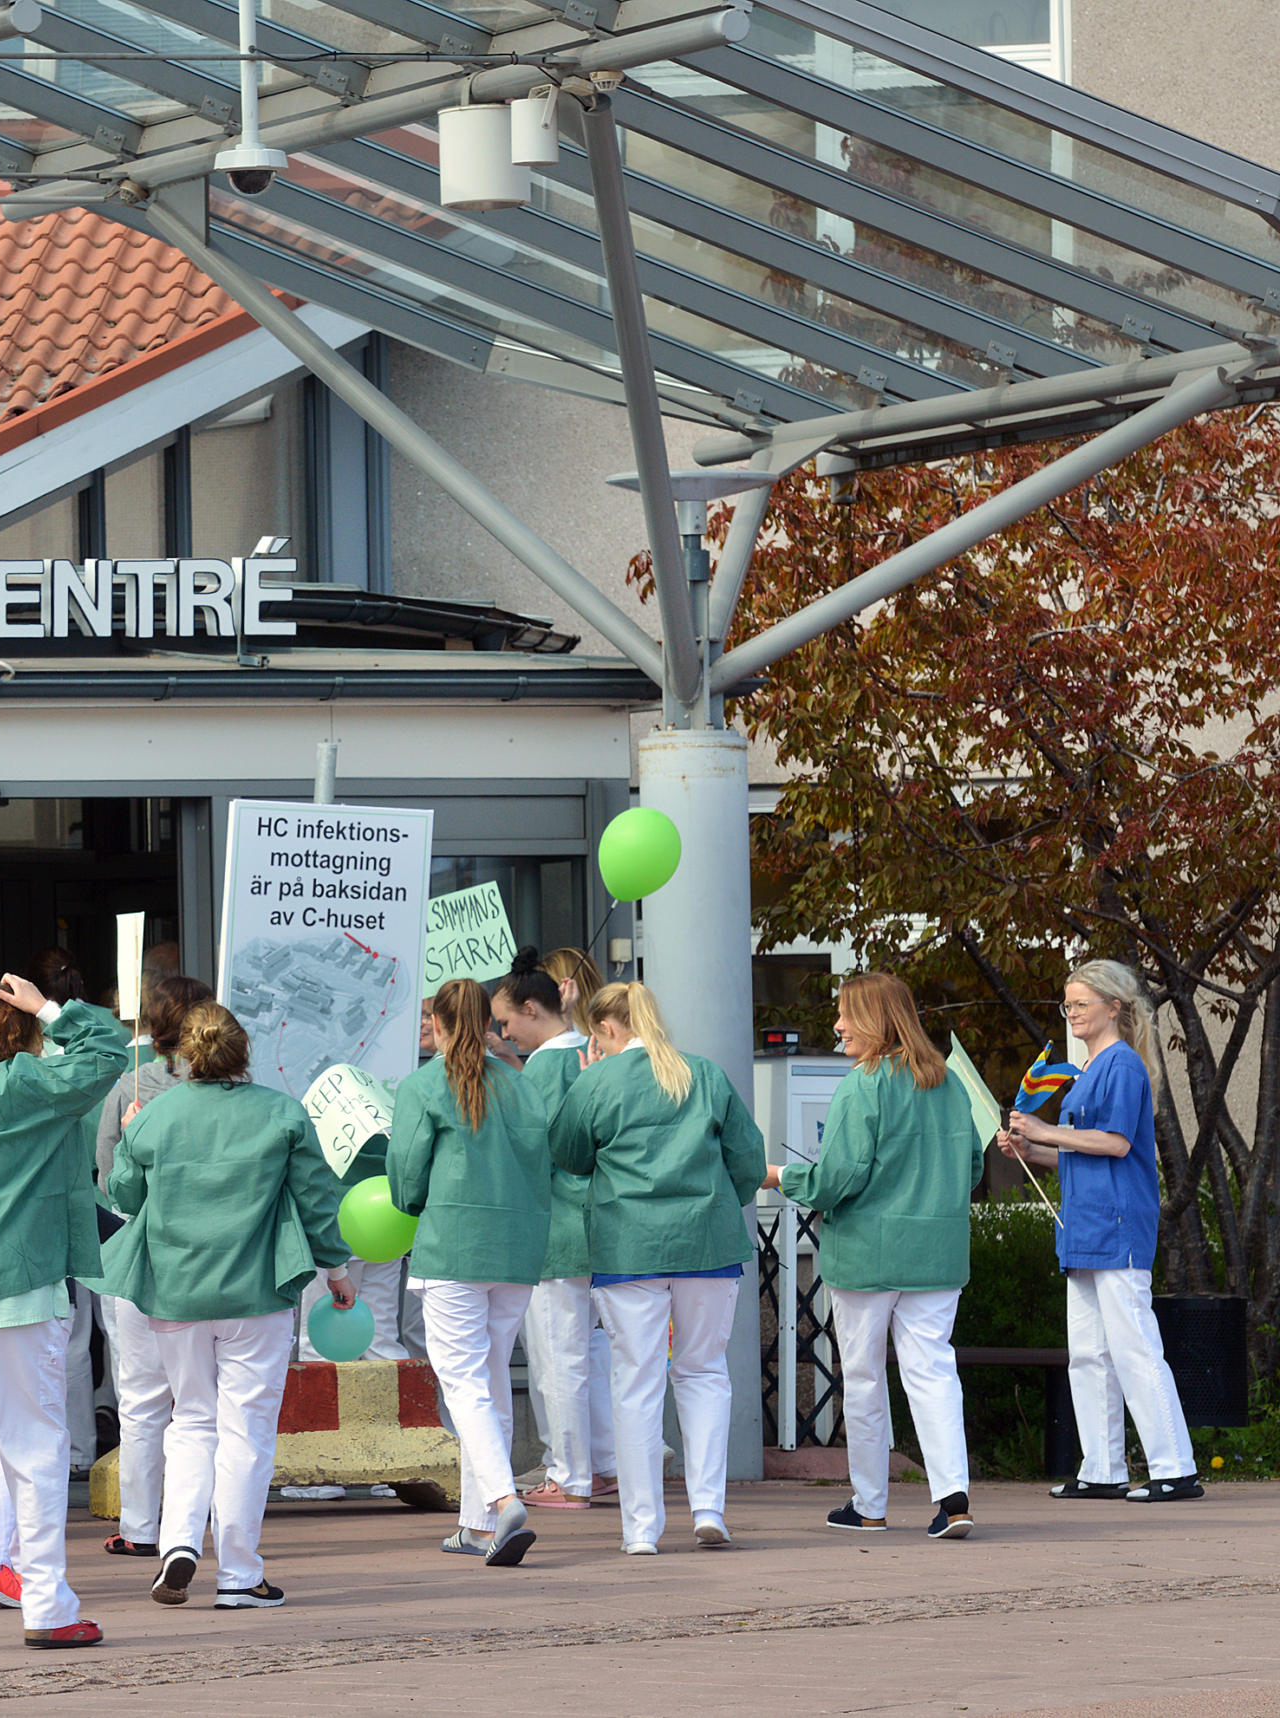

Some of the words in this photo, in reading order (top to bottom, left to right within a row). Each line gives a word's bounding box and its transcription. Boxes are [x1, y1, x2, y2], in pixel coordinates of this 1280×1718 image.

[257, 816, 288, 838] HC
[296, 819, 409, 843] infektions-
[270, 850, 391, 877] mottagning
[250, 875, 272, 896] är
[278, 876, 304, 901] på
[312, 878, 407, 902] baksidan
[270, 910, 295, 926] av
[302, 906, 385, 930] C-huset
[425, 926, 515, 983] STARKA
[337, 1093, 371, 1115] the
